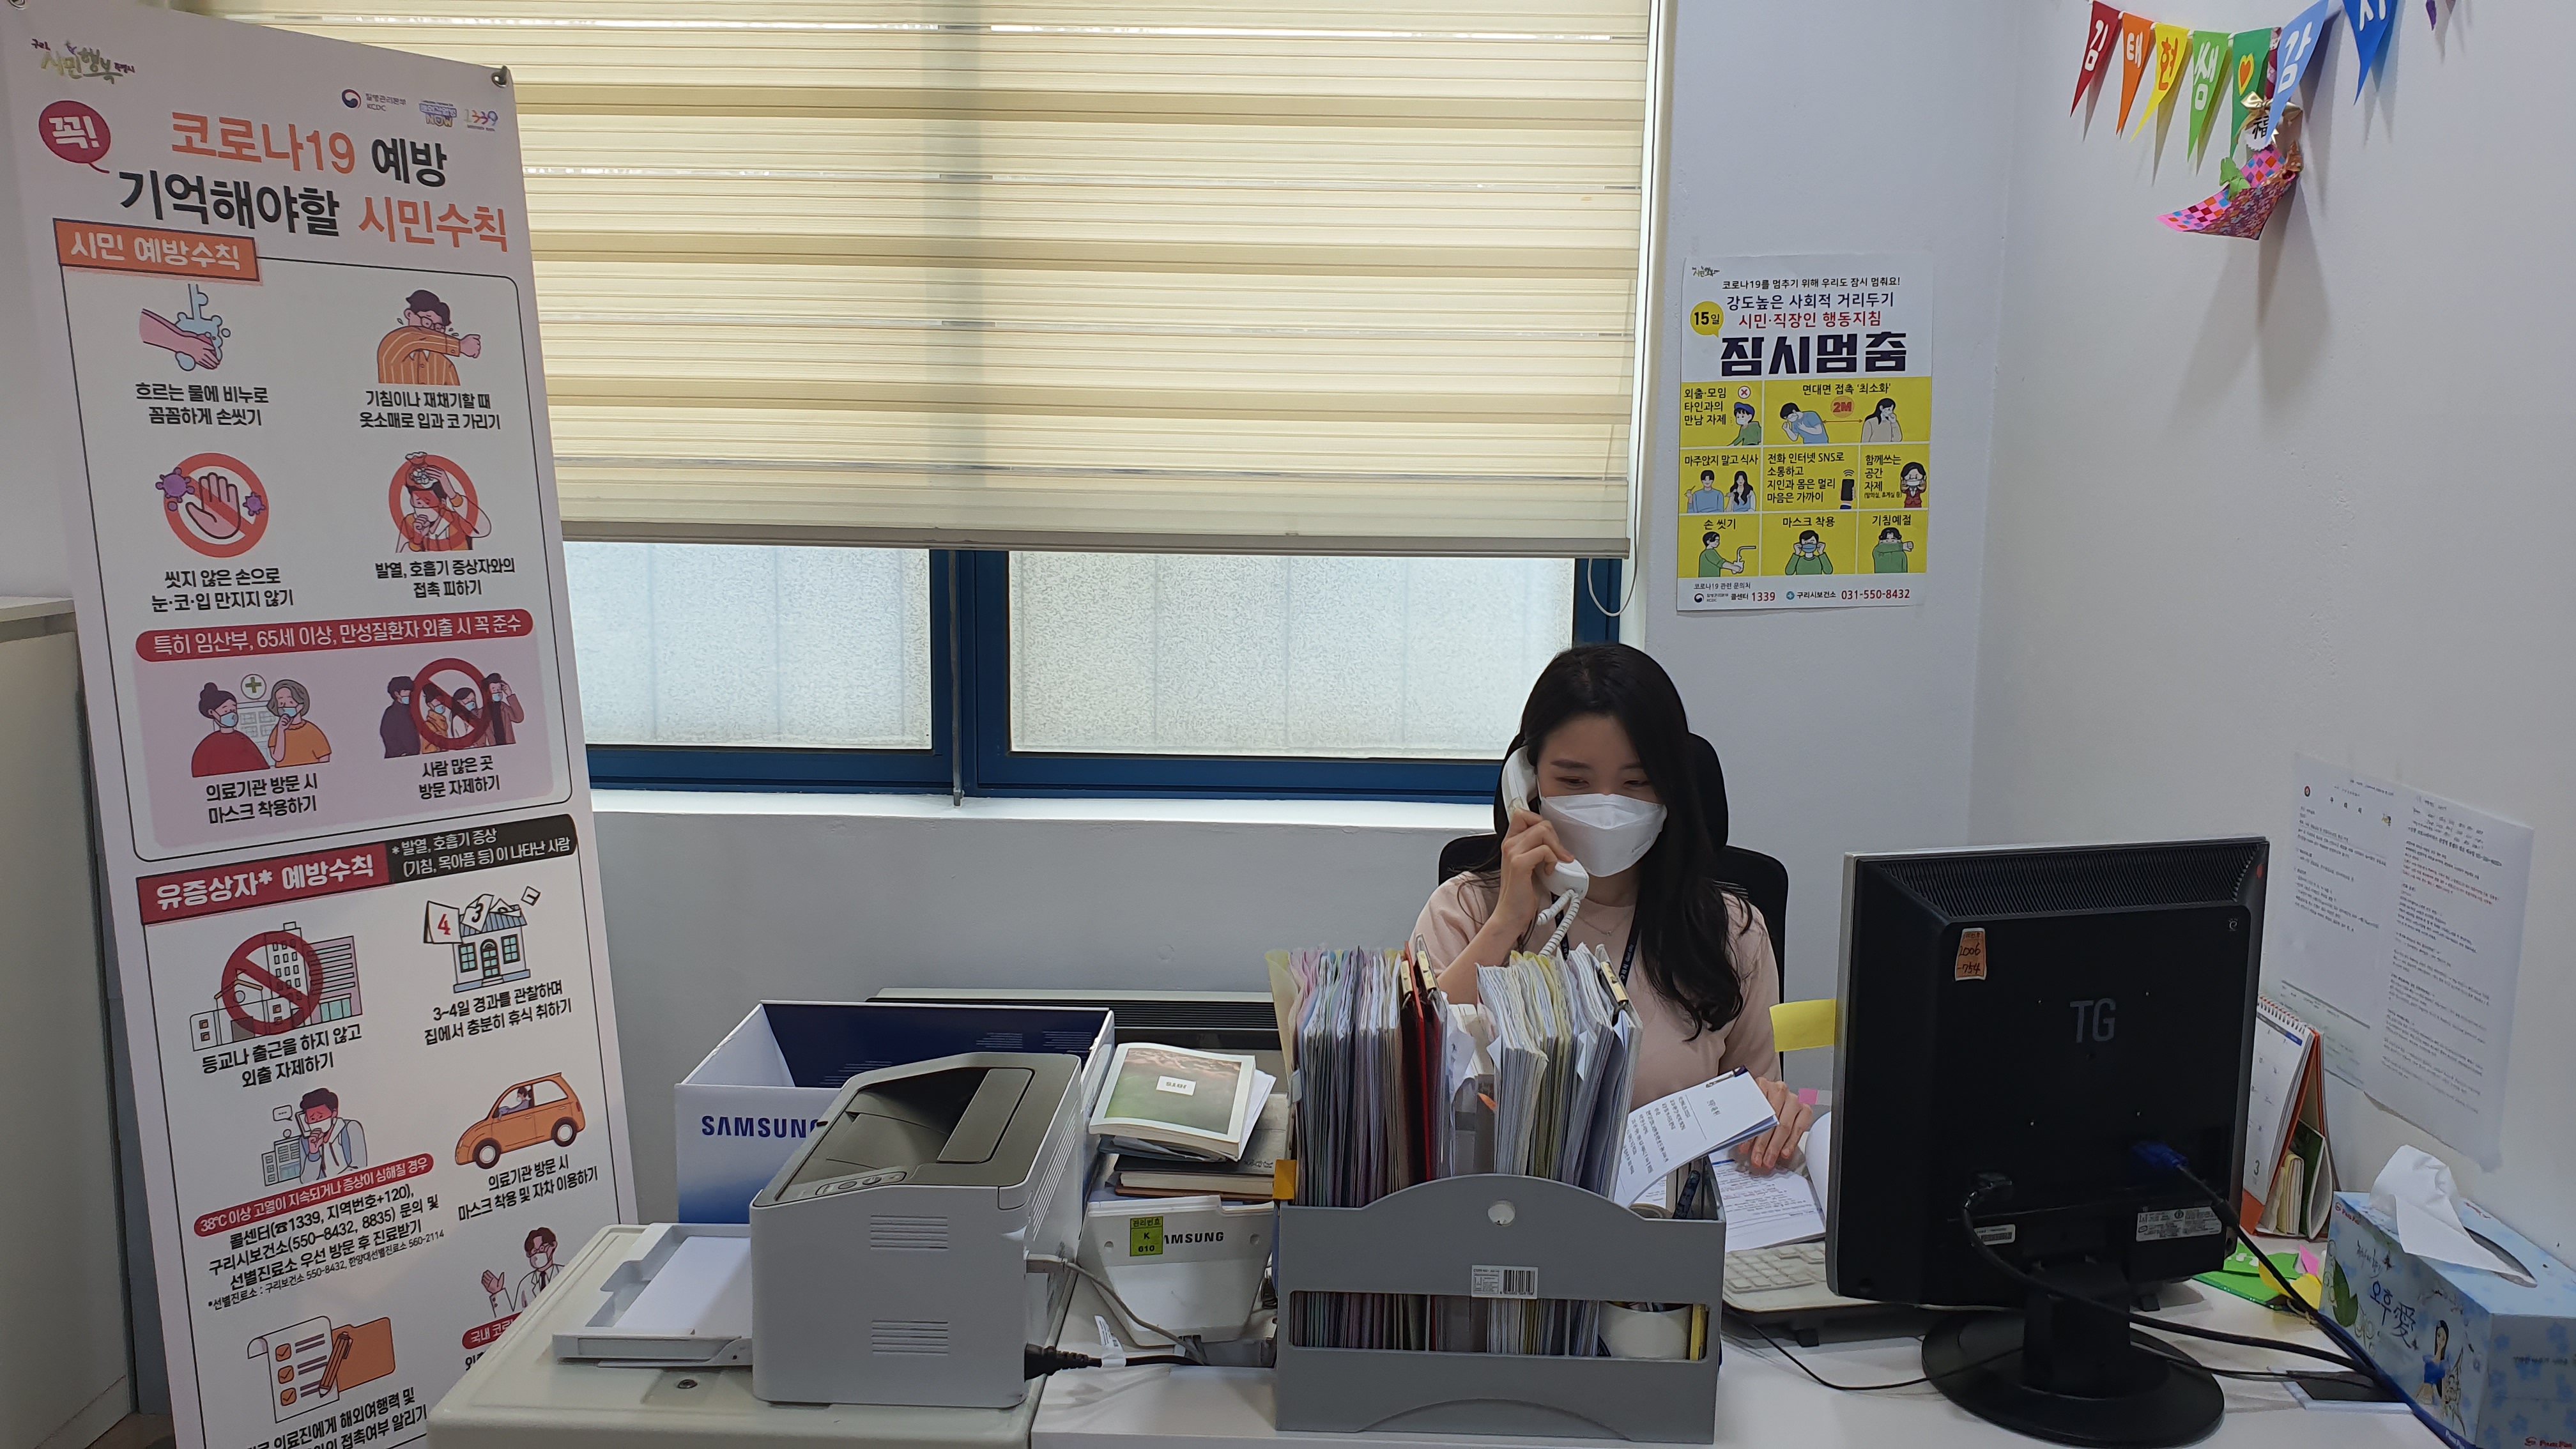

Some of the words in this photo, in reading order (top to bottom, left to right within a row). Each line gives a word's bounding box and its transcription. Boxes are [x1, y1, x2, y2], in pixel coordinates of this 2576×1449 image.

[2085, 20, 2108, 71] 김
[2127, 31, 2143, 68] 태
[2158, 37, 2178, 90] 현
[2278, 22, 2312, 93] 감
[425, 114, 452, 127] NOW
[49, 116, 100, 149] 꼭!
[172, 111, 355, 174] 코로나19
[372, 138, 447, 187] 예방
[119, 170, 339, 236] 기억해야할
[359, 196, 507, 252] 시민수칙
[71, 230, 123, 261] 시민
[135, 238, 240, 270] 예방수칙
[1722, 280, 1770, 289] 코로나19를
[1773, 280, 1798, 289] 멈추기
[1802, 279, 1818, 288] 위해
[1821, 279, 1848, 288] 우리도
[1851, 278, 1867, 287] 잠시
[1871, 277, 1900, 286] 멈춰요!
[1727, 295, 1784, 311] 강도높은
[1790, 293, 1830, 309] 사회적
[1838, 292, 1894, 308] 거리두기
[1694, 311, 1720, 326] 15일
[1739, 312, 1816, 329] 시민·직장인
[1823, 310, 1881, 327] 행동지침
[1721, 332, 1906, 376] 잠시멈춤
[135, 383, 185, 401] 흐르는
[188, 385, 218, 402] 물에
[223, 387, 269, 404] 비누로
[365, 390, 420, 408] 기침이나
[424, 391, 475, 409] 재채기할
[1802, 384, 1831, 395] 면대면
[1835, 384, 1853, 395] 접촉
[148, 406, 212, 425] 꼼꼼하게
[217, 409, 262, 426] 손씻기
[1684, 401, 1722, 412] 타인과의
[1833, 401, 1852, 413] 2M
[360, 412, 414, 429] 옷소매로
[418, 413, 444, 429] 입과
[463, 414, 501, 431] 가리기
[1684, 415, 1705, 425] 만남
[1707, 414, 1726, 425] 자제
[1685, 456, 1719, 466] 마주앉지
[1721, 456, 1738, 466] 말고
[1740, 455, 1758, 466] 식사
[1768, 454, 1785, 465] 전화
[1788, 453, 1815, 464] 인터넷
[1818, 452, 1844, 463] SNS로
[1865, 454, 1901, 466] 함께쓰는
[1767, 467, 1803, 477] 소통하고
[1865, 468, 1883, 479] 공간
[1767, 479, 1794, 489] 지인과
[1797, 479, 1814, 489] 몸은
[1818, 479, 1835, 489] 멀리
[1864, 482, 1882, 492] 자제
[1767, 493, 1794, 503] 마음은
[1797, 493, 1823, 503] 가까이
[1703, 519, 1713, 530] 손
[1717, 518, 1736, 529] 씻기
[1782, 518, 1812, 528] 마스크
[1815, 517, 1835, 527] 착용
[1872, 515, 1911, 525] 기침예절
[165, 570, 196, 588] 씻지
[201, 569, 232, 587] 않은
[236, 568, 281, 585] 손으로
[376, 562, 406, 579] 발열,
[410, 560, 448, 578] 호흡기
[453, 558, 515, 576] 증상자와의
[414, 581, 440, 599] 접촉
[444, 580, 482, 597] 피하기
[1752, 592, 1775, 601] 1339
[1797, 591, 1836, 599] 구리시보건소
[1841, 589, 1910, 600] 031-550-8432
[151, 593, 210, 612] 눈·코·입
[215, 591, 261, 610] 만지지
[264, 589, 293, 608] 않기
[153, 634, 190, 655] 특히
[196, 632, 253, 653] 임산부,
[257, 629, 295, 649] 65세
[302, 626, 336, 647] 이상,
[340, 621, 420, 643] 만성질환자
[423, 618, 454, 636] 외출
[493, 614, 522, 634] 준수
[423, 760, 448, 778] 사람
[452, 757, 477, 774] 많은
[206, 779, 267, 801] 의료기관
[270, 777, 299, 794] 방문
[419, 783, 445, 799] 방문
[449, 776, 500, 796] 자제하기
[209, 804, 254, 824] 마스크
[258, 799, 316, 818] 착용하기
[434, 834, 470, 852] 호흡기
[473, 829, 497, 845] 증상
[402, 859, 436, 877] (기침,
[439, 852, 475, 870] 목아픔
[512, 840, 546, 860] 나타난
[548, 837, 570, 854] 사람
[282, 854, 374, 890] 예방수칙
[433, 1002, 470, 1022] 3~4일
[472, 993, 511, 1013] 경과를
[514, 979, 563, 1006] 관찰하며
[425, 1023, 463, 1045] 집에서
[466, 1014, 505, 1038] 충분히
[508, 1008, 533, 1027] 휴식
[537, 997, 572, 1019] 취하기
[2069, 998, 2116, 1043] TG
[203, 1050, 249, 1074] 등교나
[252, 1041, 297, 1065] 출근을
[301, 1031, 330, 1051] 하지
[333, 1025, 362, 1043] 않고
[242, 1066, 271, 1088] 외출
[275, 1053, 334, 1080] 자제하기
[488, 1165, 532, 1191] 의료기관
[535, 1158, 556, 1177] 방문
[2253, 1160, 2260, 1175] 3
[229, 1209, 251, 1222] 이상
[253, 1198, 287, 1216] 고열이
[289, 1184, 341, 1207] 지속되거나
[342, 1172, 374, 1191] 증상이
[376, 1164, 406, 1183] 심해질
[408, 1158, 428, 1172] 경우
[459, 1198, 493, 1221] 마스크
[494, 1191, 517, 1209] 착용
[533, 1179, 555, 1199] 자차
[557, 1166, 599, 1191] 이용하기
[362, 1207, 397, 1228] 8835)
[399, 1199, 424, 1216] 문의
[1163, 1232, 1223, 1244] AMSUNG
[231, 1258, 298, 1291] 선별진료소
[300, 1250, 326, 1268] 우선
[329, 1241, 355, 1259] 방문
[373, 1218, 422, 1245] 진료받기
[265, 1276, 304, 1293] 구리보건소
[307, 1260, 347, 1280] 550-8432,
[408, 1229, 445, 1247] 560-2114
[340, 1393, 400, 1429] 해외여행력
[392, 1404, 427, 1431] 알리기
